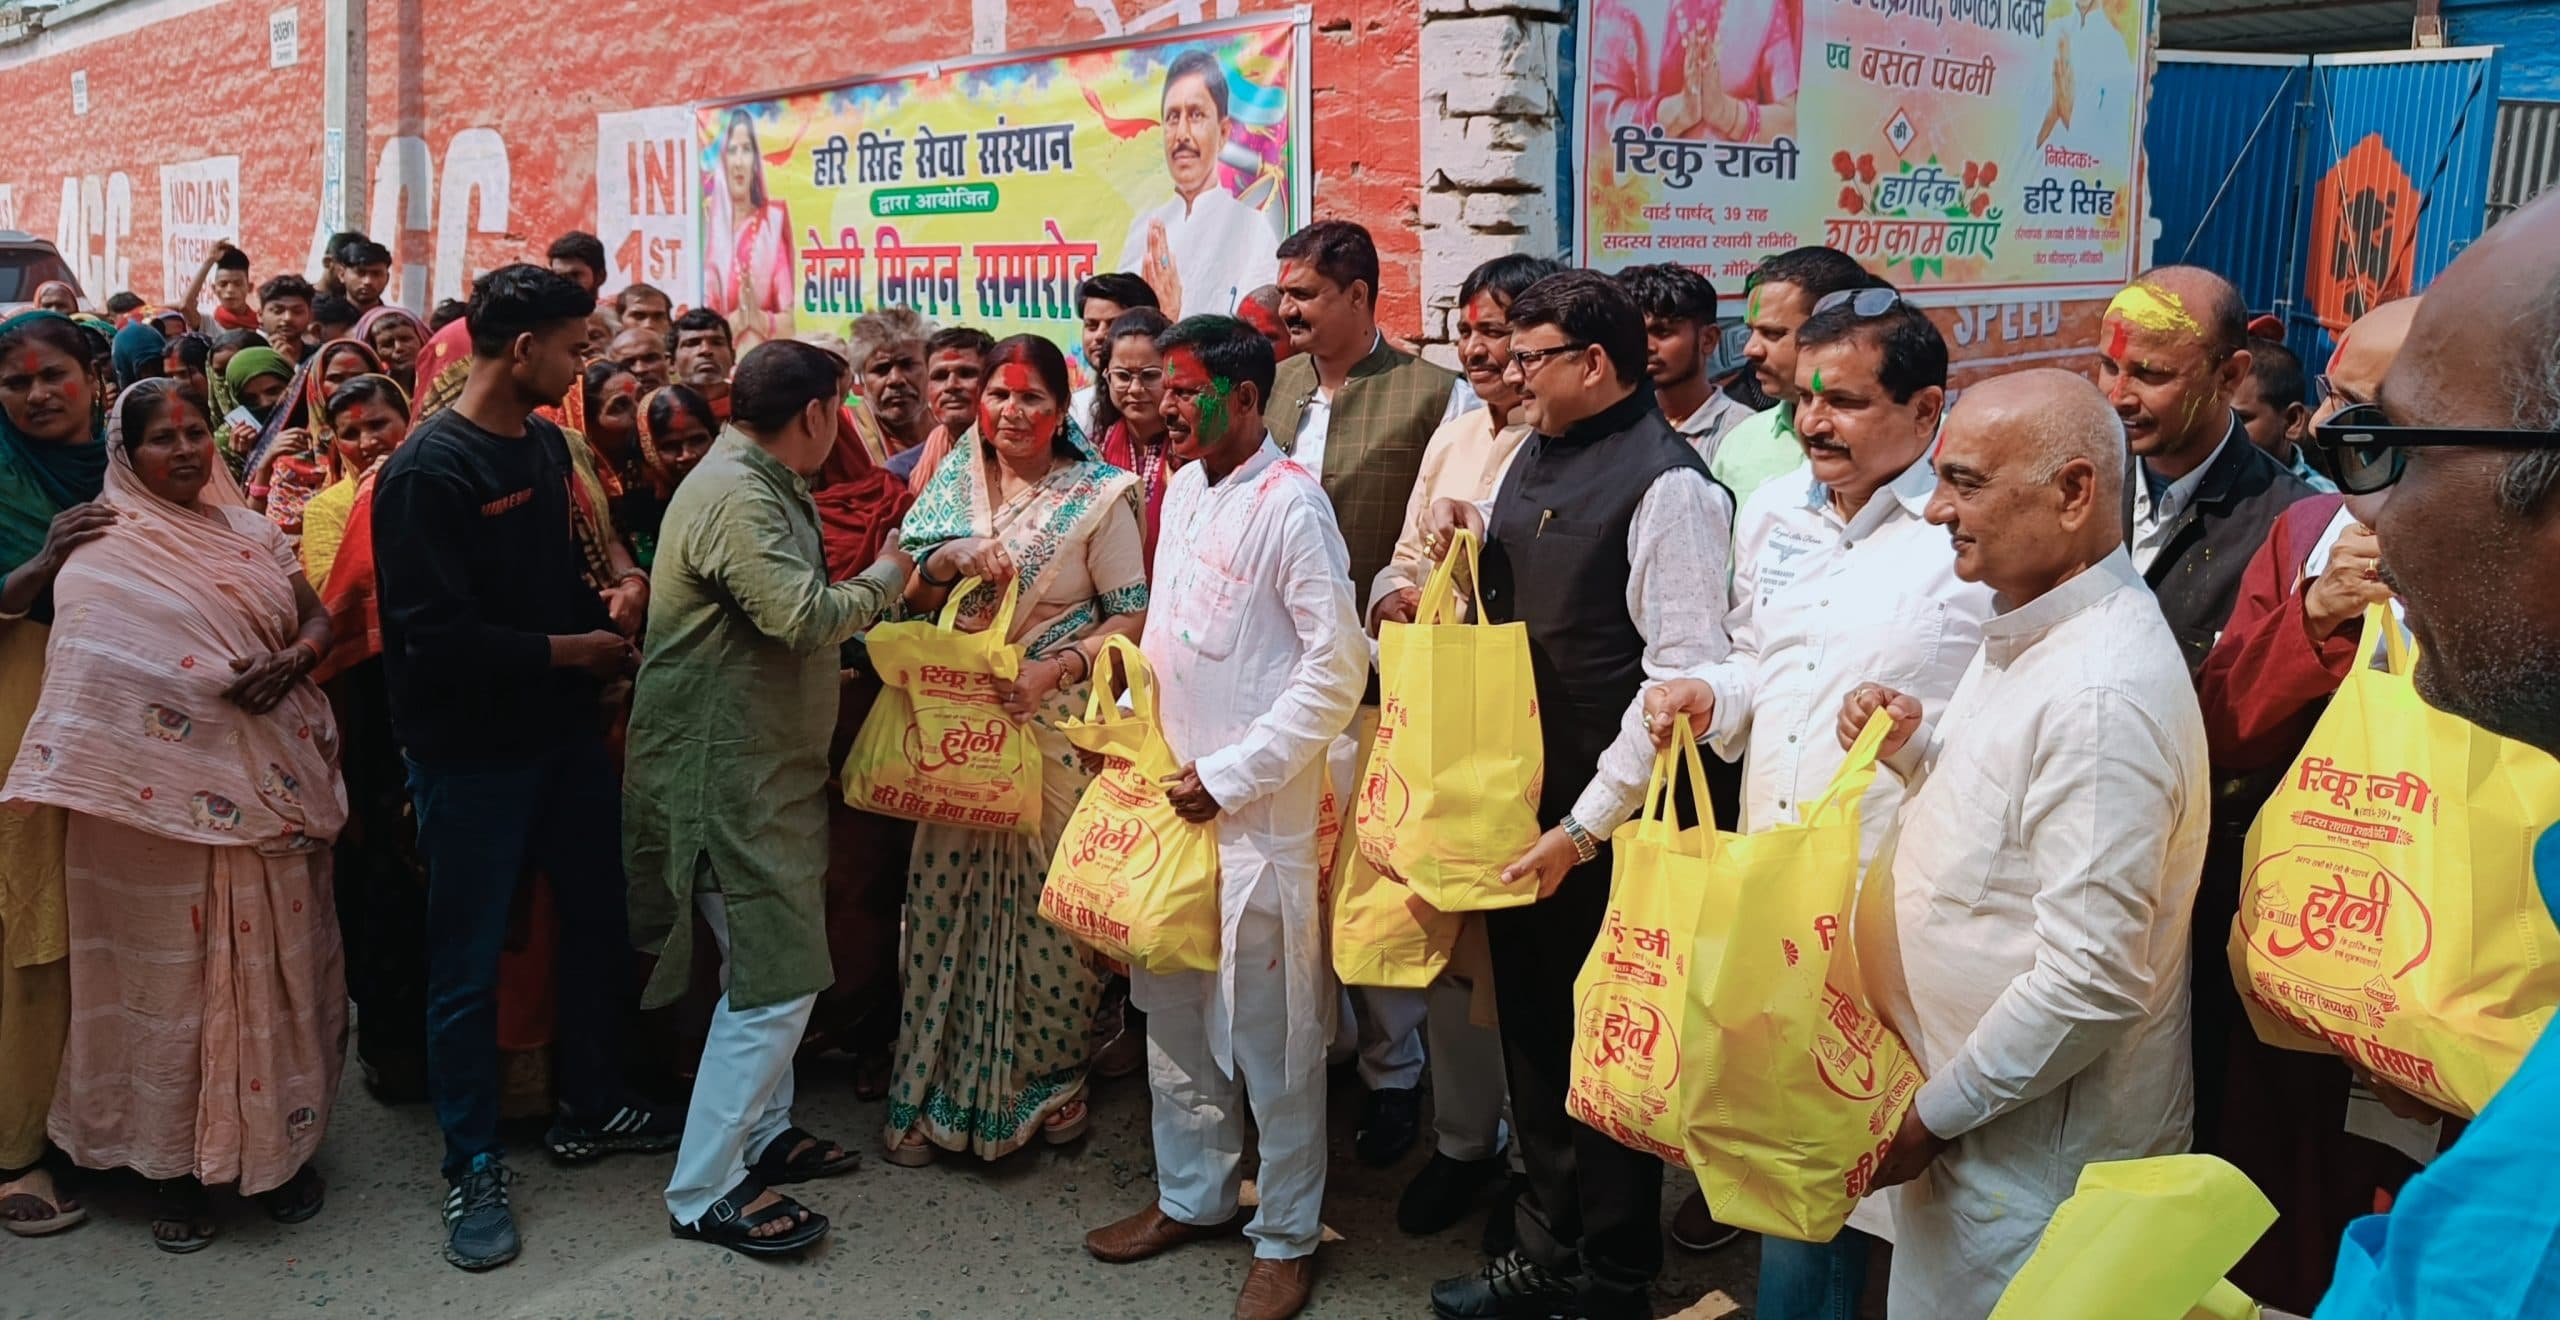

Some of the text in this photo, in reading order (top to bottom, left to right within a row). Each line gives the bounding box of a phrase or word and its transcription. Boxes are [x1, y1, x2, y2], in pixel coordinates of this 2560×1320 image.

[1826, 38, 1996, 96] एवं बसंत पंचमी
[813, 116, 1074, 186] हरि सिंह सेवा संस्थान
[1893, 121, 1908, 140] की
[1612, 126, 1800, 189] रिंकु रानी
[169, 178, 231, 226] INDIA'S
[877, 187, 991, 214] द्वारा आयोजित
[1879, 167, 1960, 209] हार्दिक
[2023, 177, 2116, 217] हरि सिंह
[1723, 206, 1742, 222] 39
[1747, 207, 1769, 222] सह
[1603, 234, 1651, 250] सदस्य
[1712, 231, 1752, 250] स्थायी
[1757, 231, 1798, 248] समिति
[801, 227, 865, 313] होली
[874, 226, 962, 316] मिलन
[919, 665, 970, 689] रिंकू
[918, 719, 1008, 771] होली
[872, 784, 1021, 826] हरि सिंह सेवा संस्थान
[2267, 871, 2393, 958] होली
[2294, 987, 2316, 1006] सिंह
